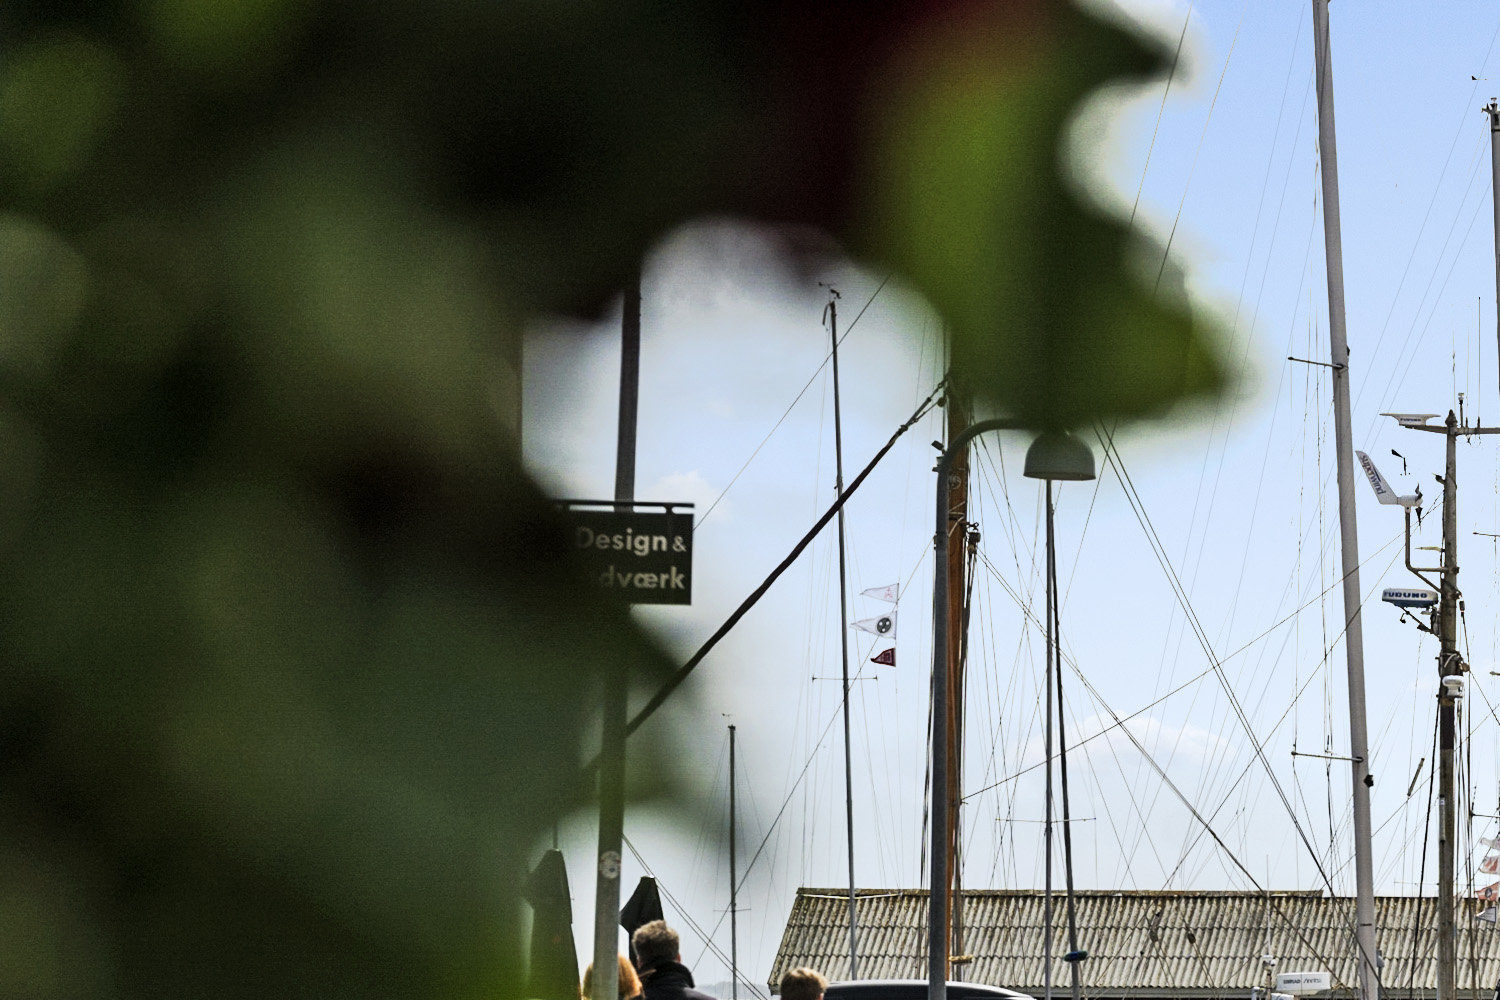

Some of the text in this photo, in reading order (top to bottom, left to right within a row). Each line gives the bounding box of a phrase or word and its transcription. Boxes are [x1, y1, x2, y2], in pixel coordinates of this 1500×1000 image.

[576, 526, 687, 557] Design &
[599, 565, 685, 590] dværk
[1383, 591, 1428, 599] FURUNO
